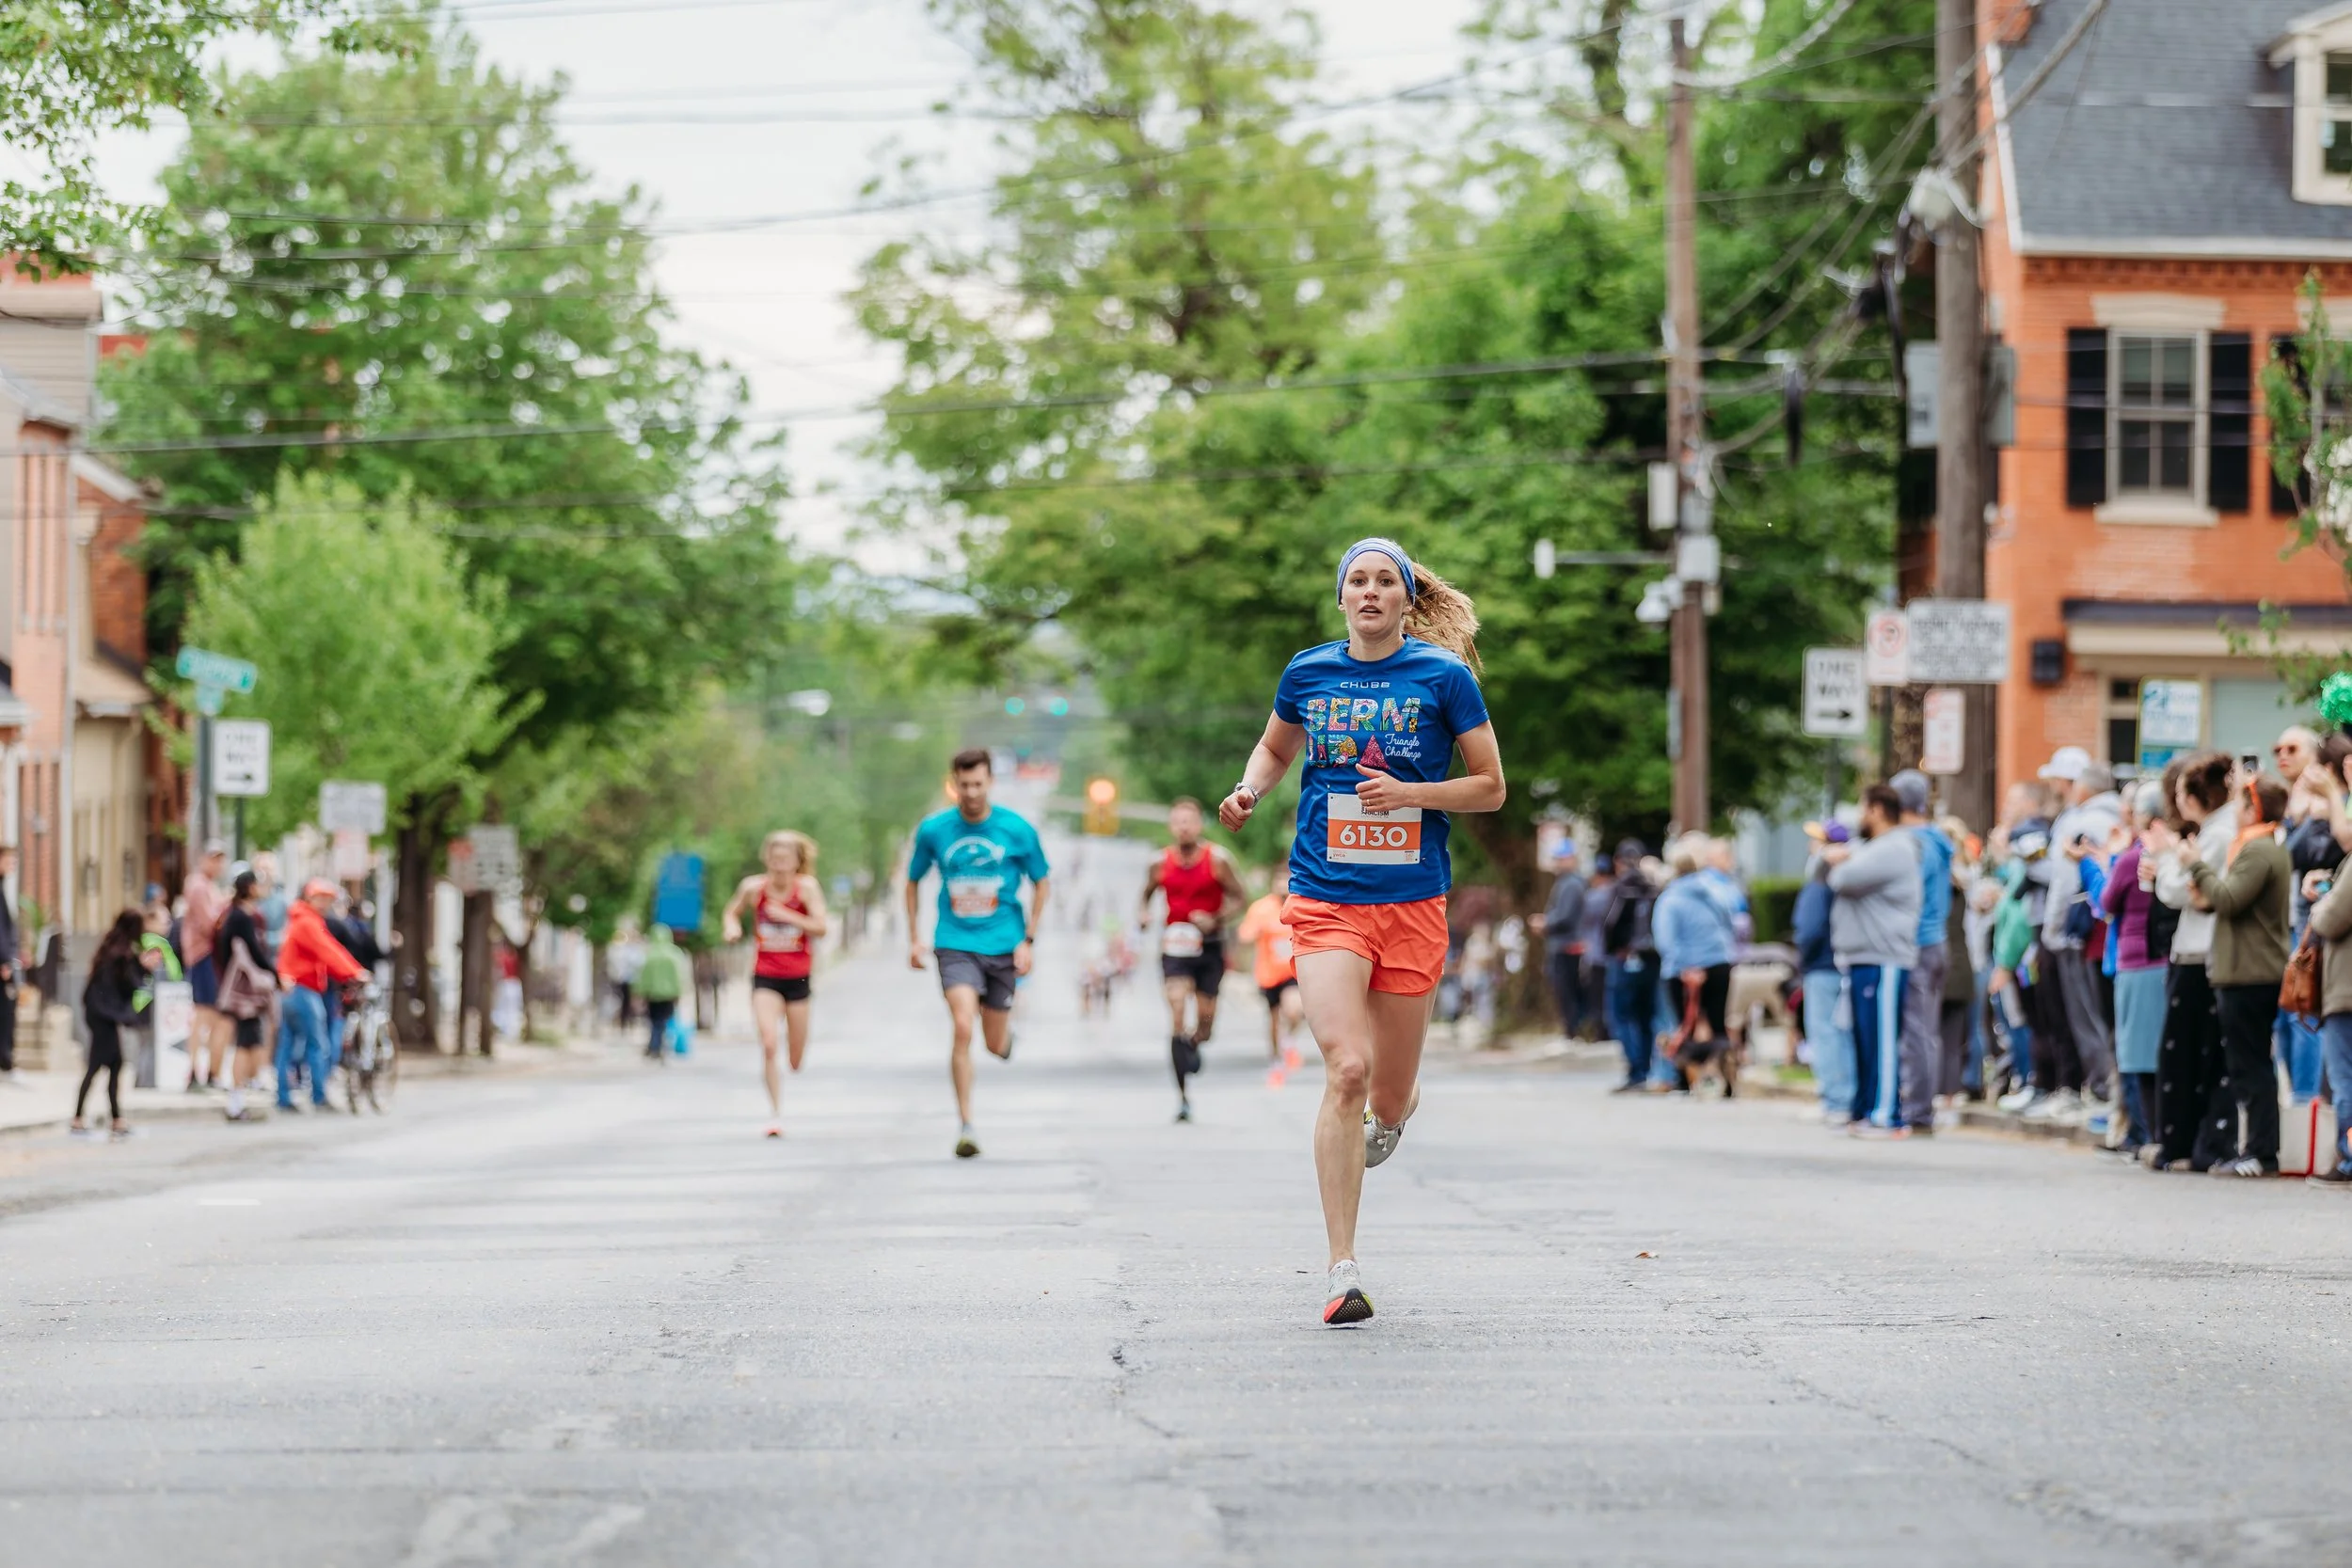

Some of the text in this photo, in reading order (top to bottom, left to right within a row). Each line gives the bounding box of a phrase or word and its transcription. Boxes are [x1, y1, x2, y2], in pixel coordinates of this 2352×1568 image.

[1306, 697, 1422, 733] BERM
[1385, 734, 1420, 749] Triangle
[1385, 746, 1422, 761] Challenge
[1340, 825, 1407, 847] 6130
